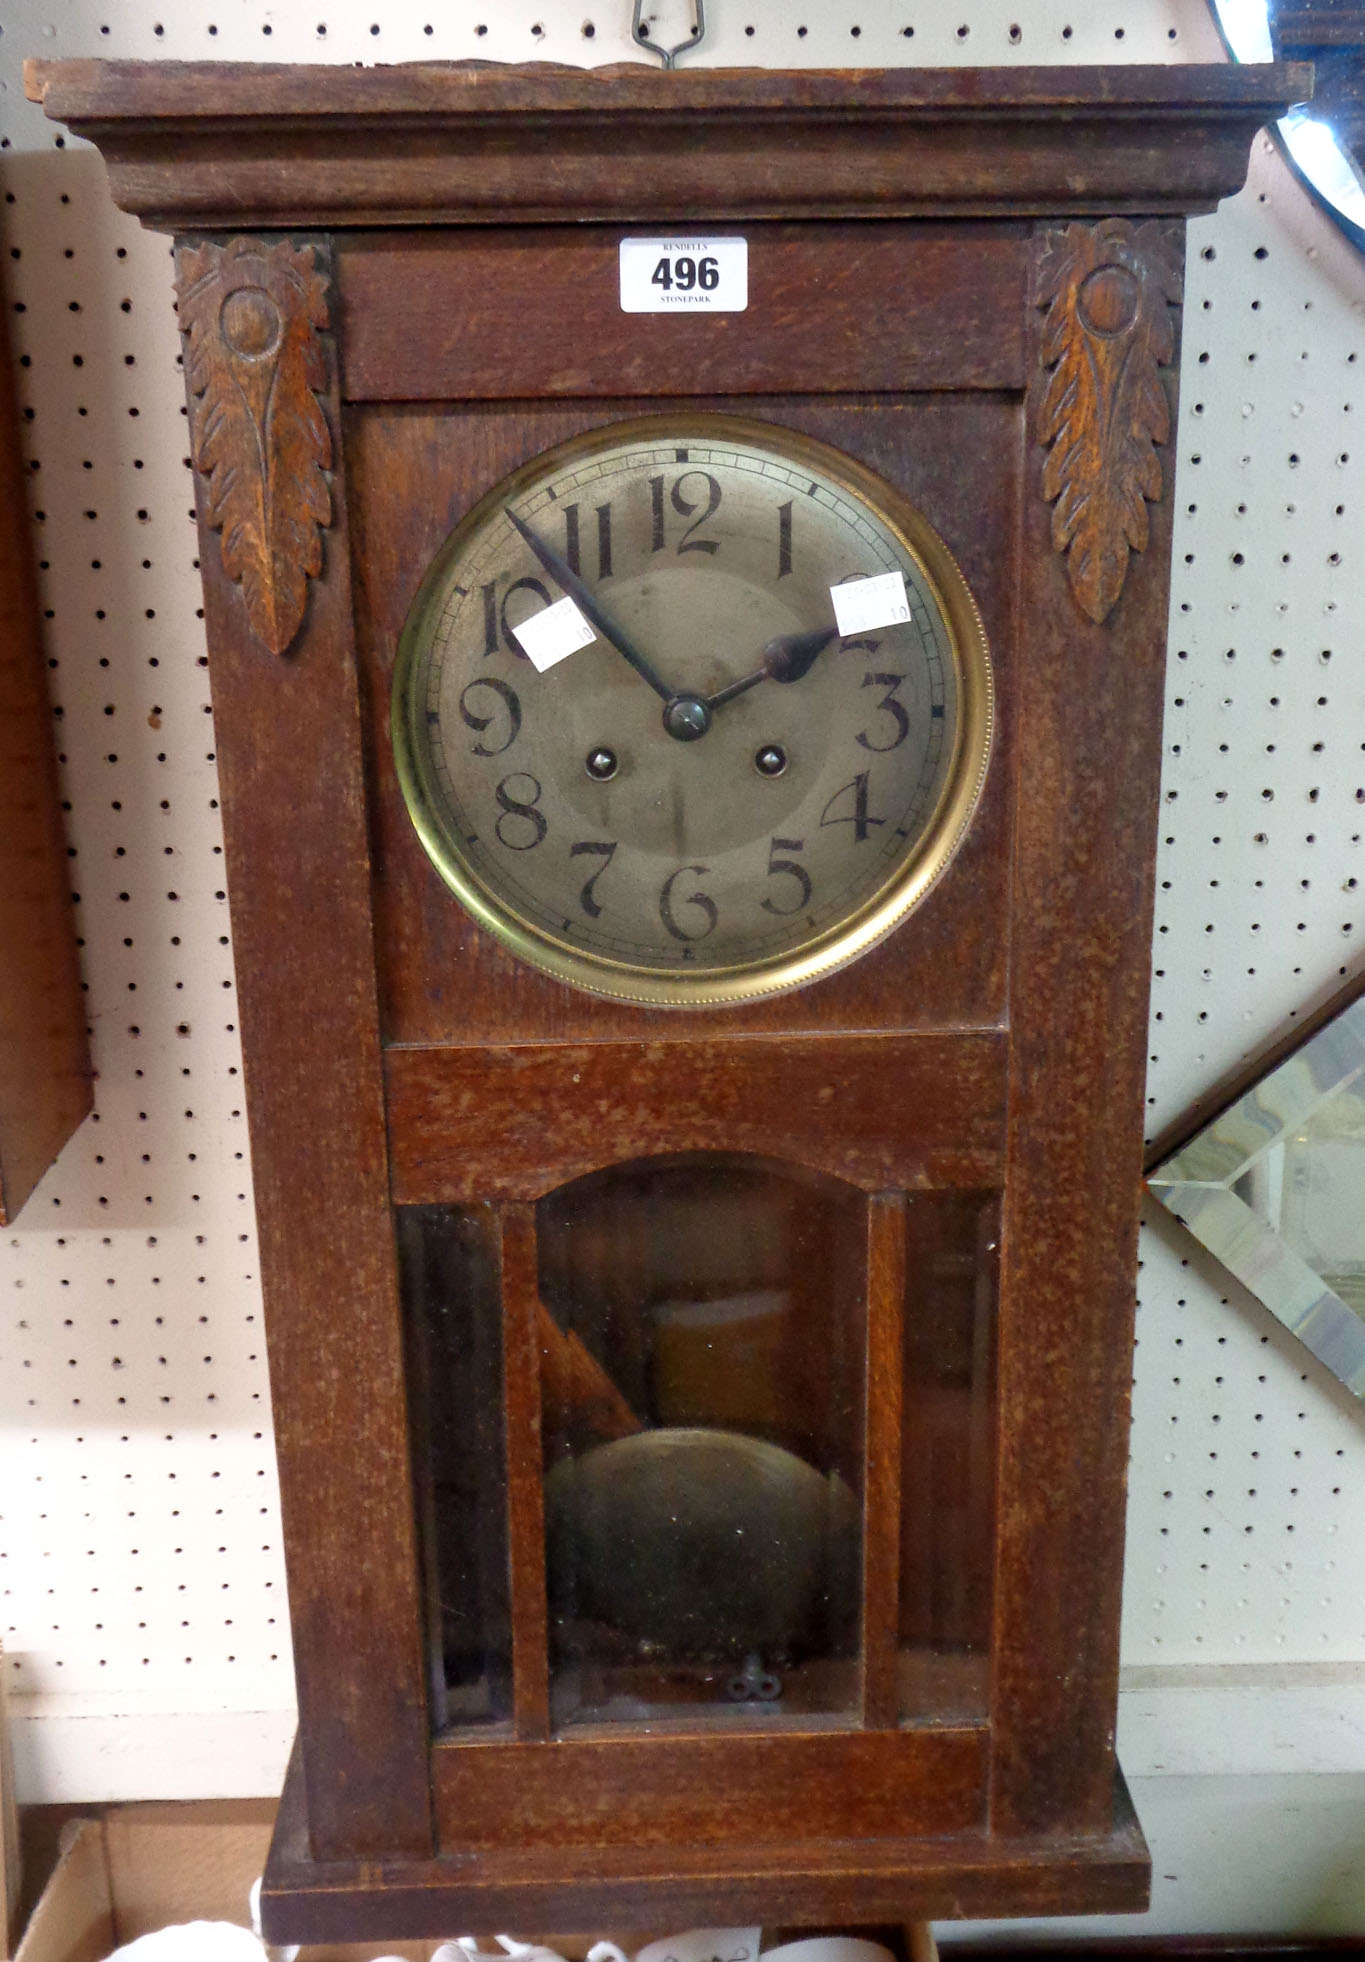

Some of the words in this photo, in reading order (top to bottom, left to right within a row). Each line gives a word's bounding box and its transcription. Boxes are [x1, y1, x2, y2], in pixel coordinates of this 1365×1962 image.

[651, 257, 720, 291] 496
[663, 243, 708, 251] RENDELLS
[660, 295, 711, 303] STONEPARK
[563, 502, 612, 581] 11
[648, 470, 722, 556] 12
[777, 500, 793, 580] 1
[459, 677, 522, 757] 9
[855, 673, 910, 752] 3
[495, 772, 547, 851] 8
[820, 770, 886, 843] 4
[570, 841, 618, 918] 7
[659, 865, 719, 942] 6
[760, 838, 813, 915] 5
